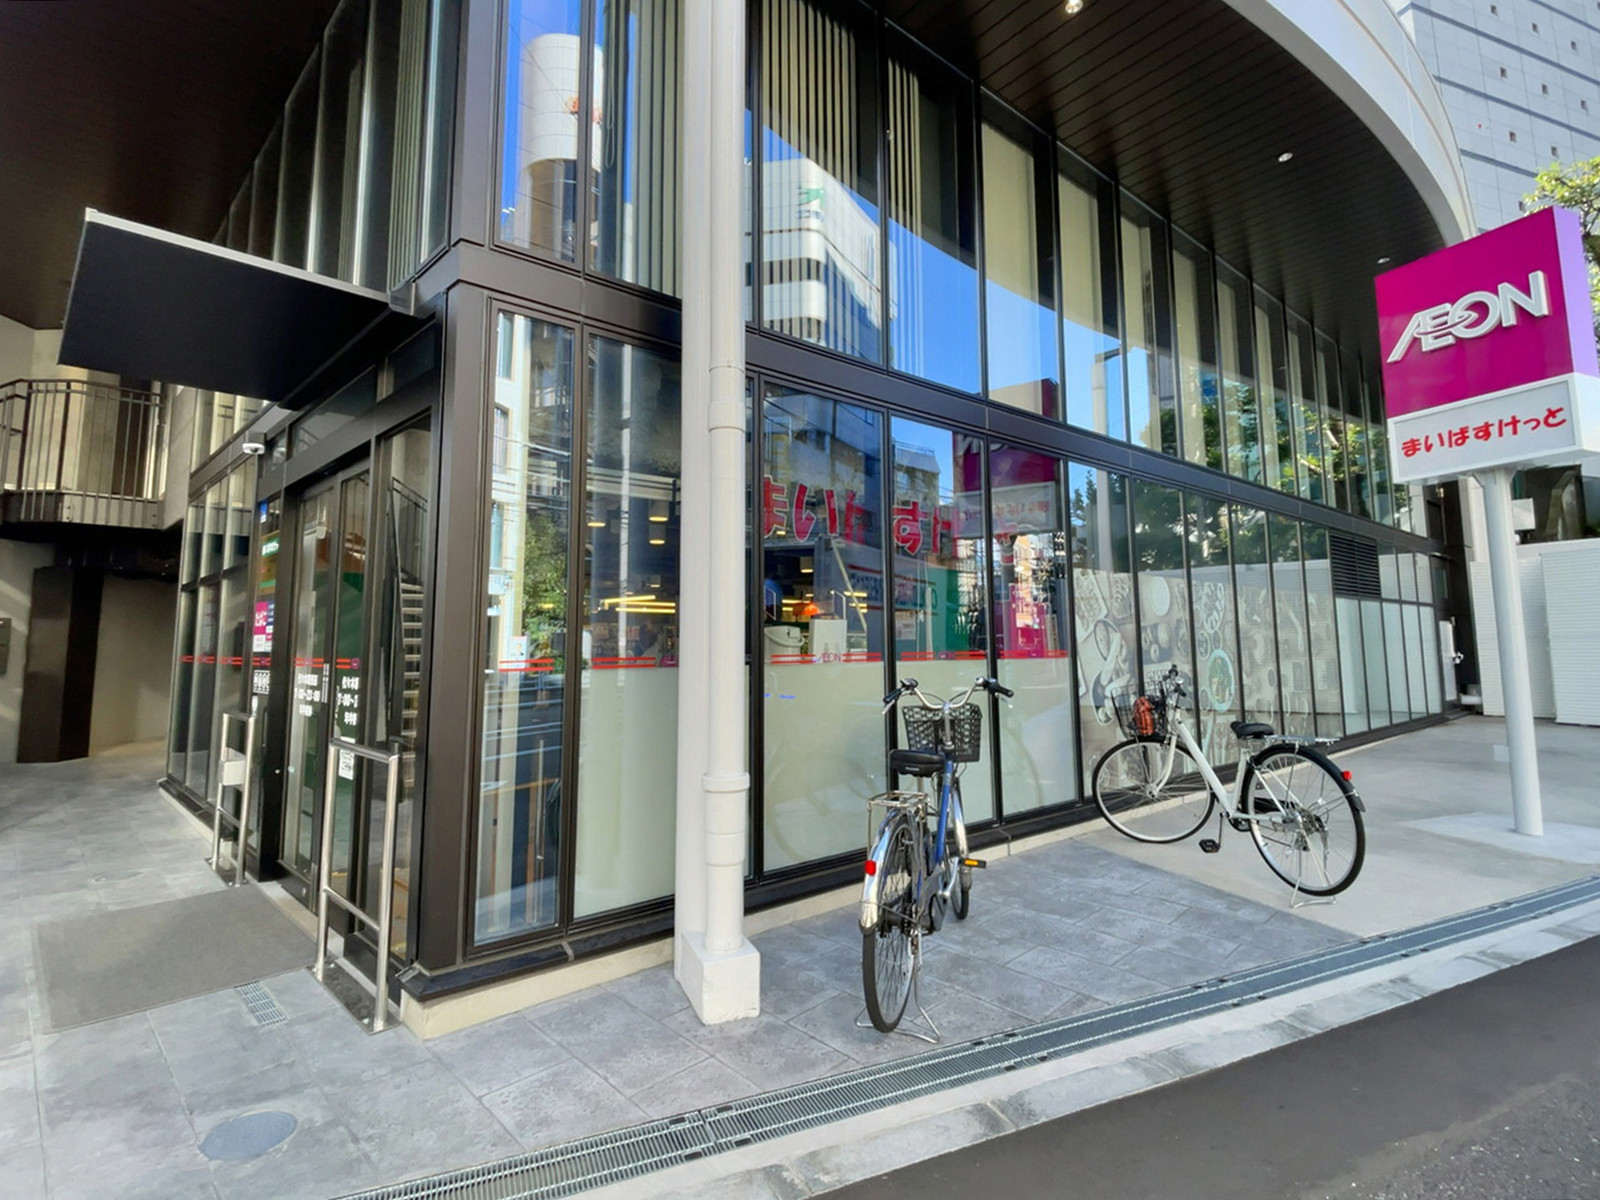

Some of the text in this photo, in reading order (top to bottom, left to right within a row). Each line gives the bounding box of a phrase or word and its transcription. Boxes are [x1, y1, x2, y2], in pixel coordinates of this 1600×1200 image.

[1402, 406, 1567, 457] まいばすけっと
